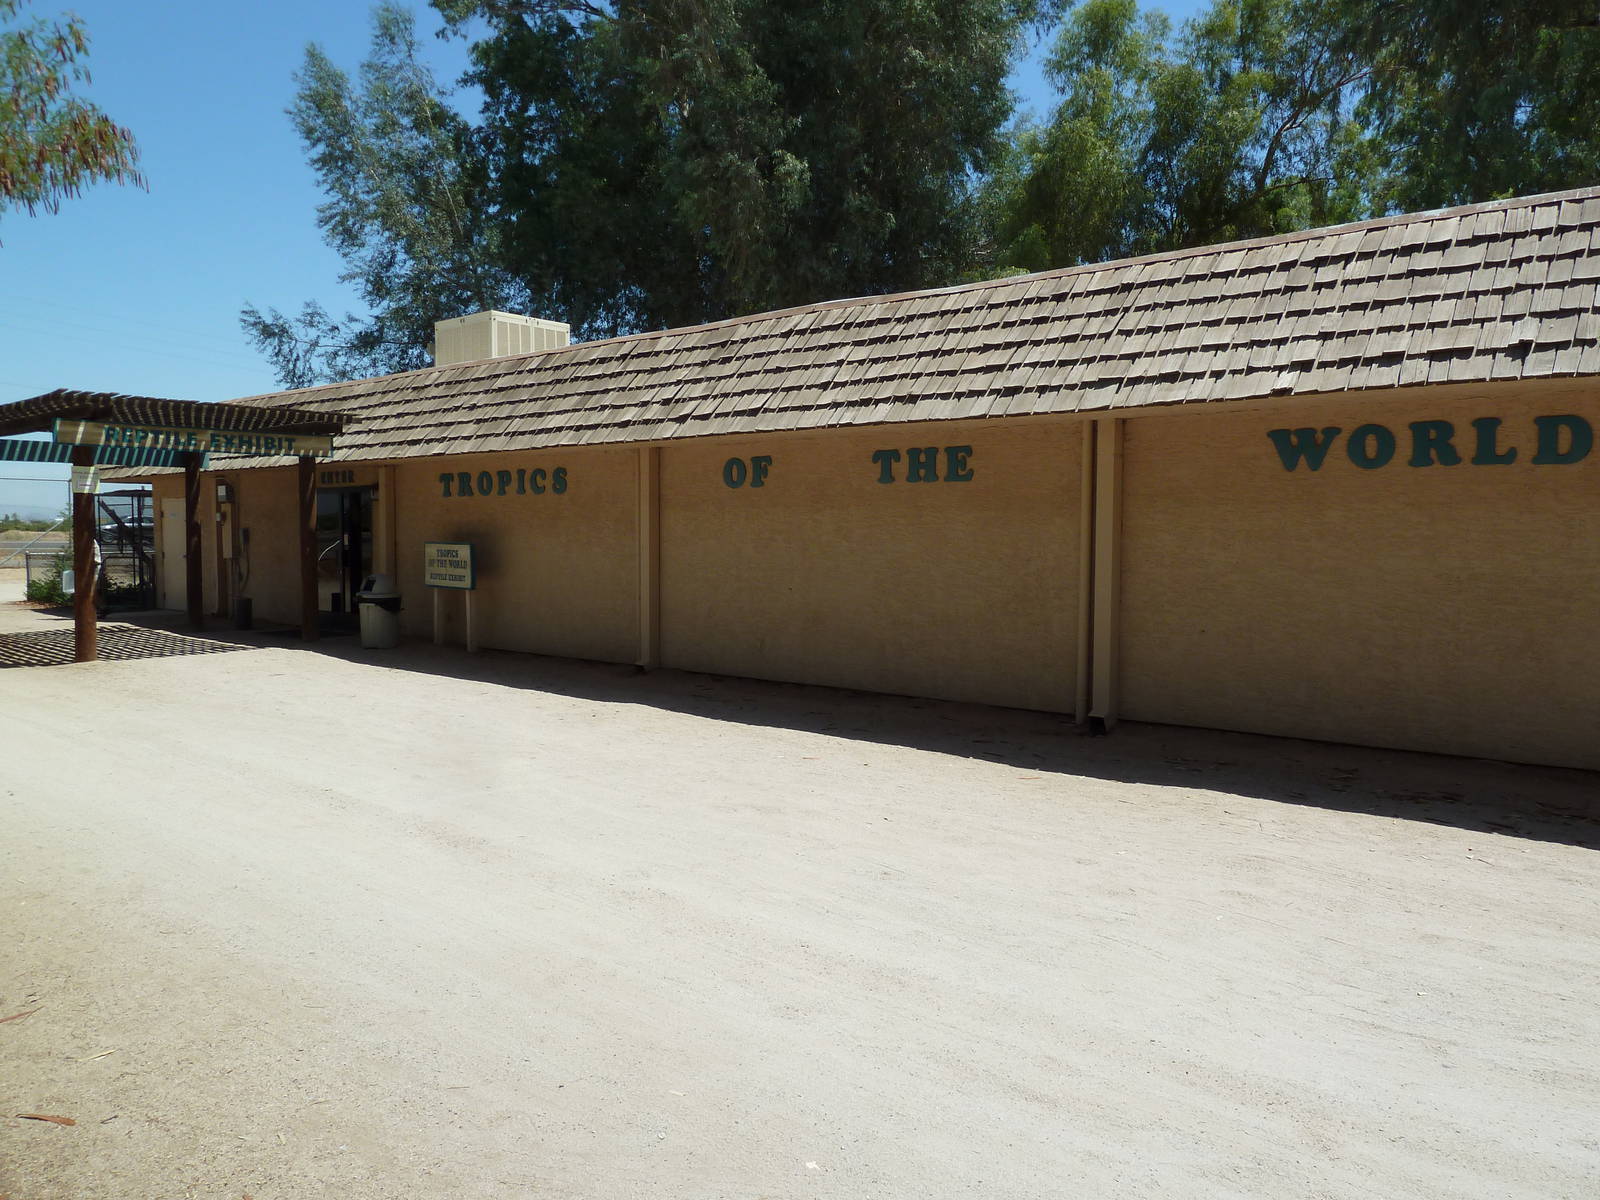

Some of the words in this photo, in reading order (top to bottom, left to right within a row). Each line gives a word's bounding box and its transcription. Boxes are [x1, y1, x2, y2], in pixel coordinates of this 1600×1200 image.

[104, 426, 198, 448] REPTILE
[210, 432, 296, 451] EXHIBIT
[439, 467, 567, 497] TROPICS
[723, 456, 773, 488] OF
[871, 445, 975, 484] THE
[1266, 414, 1593, 472] WORLD
